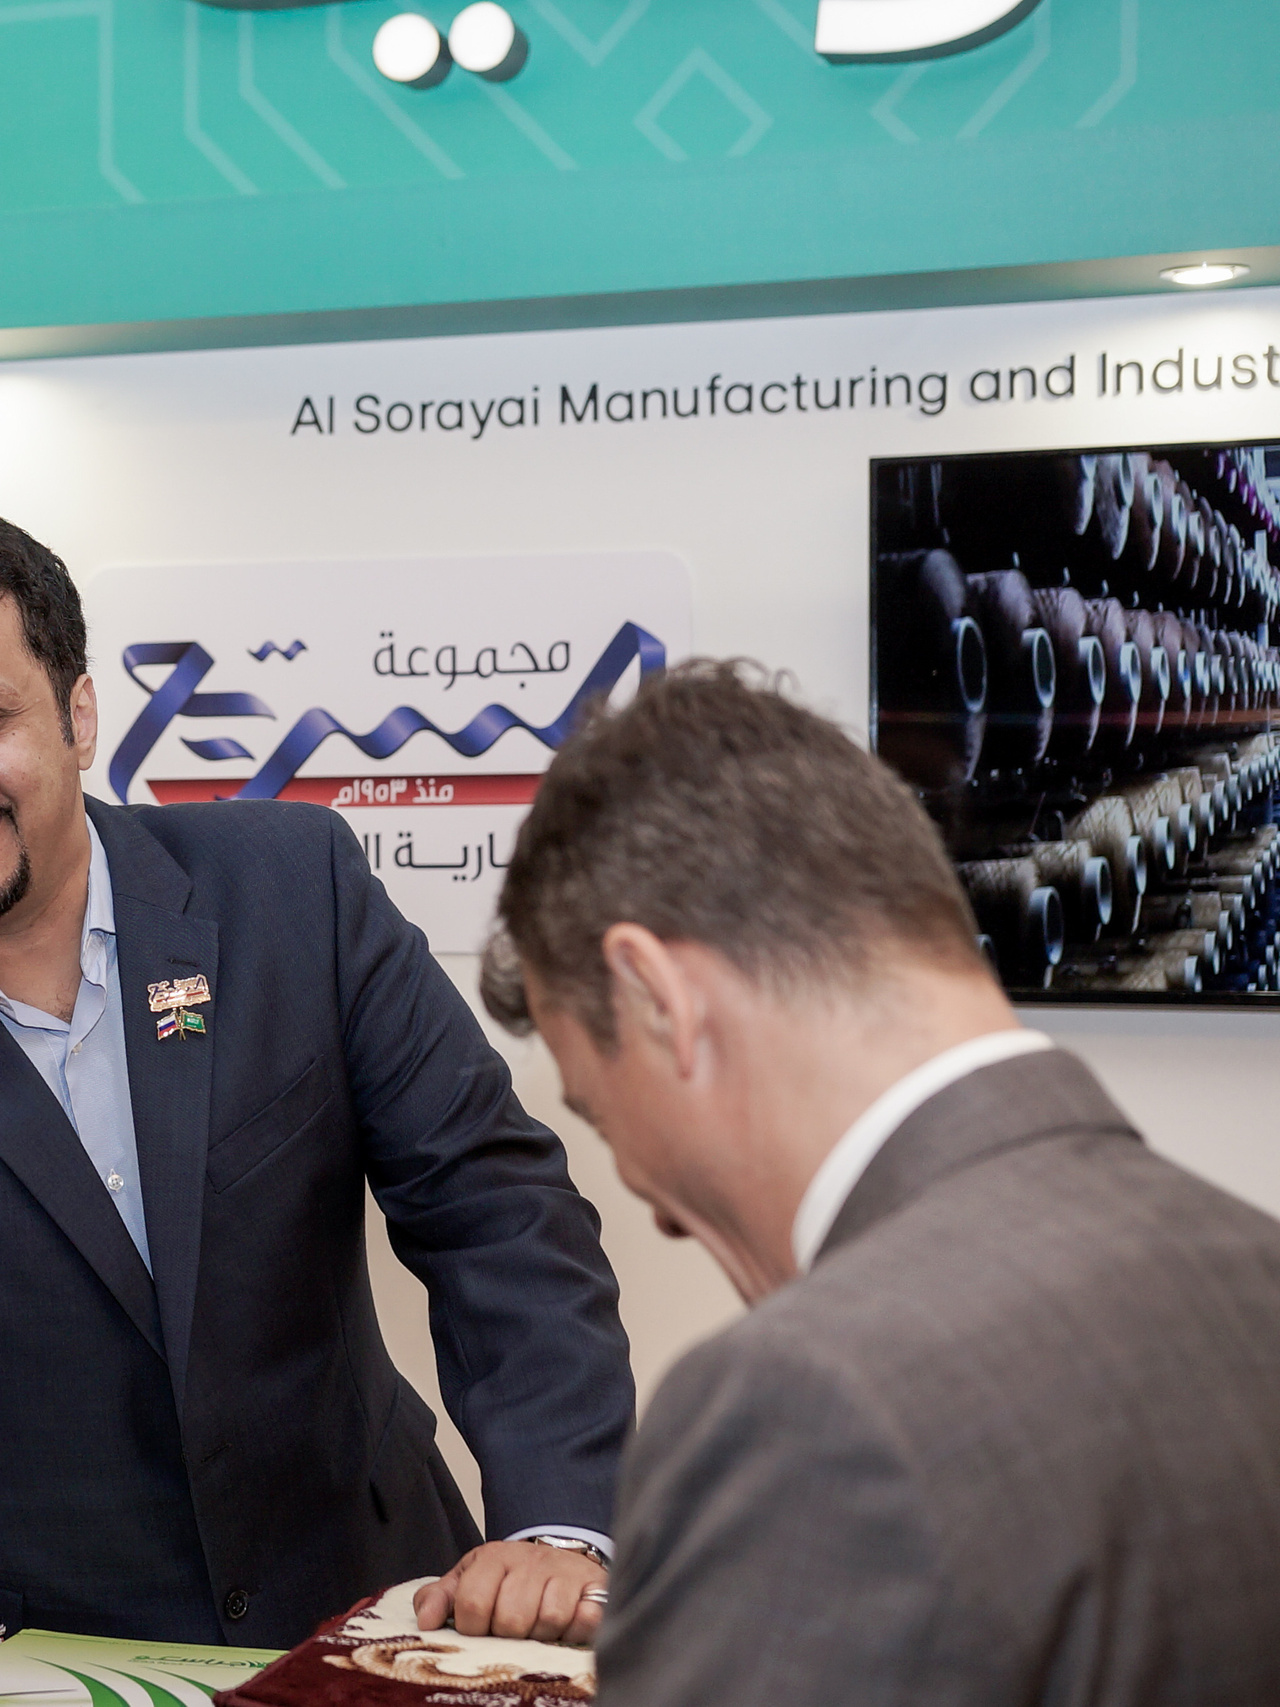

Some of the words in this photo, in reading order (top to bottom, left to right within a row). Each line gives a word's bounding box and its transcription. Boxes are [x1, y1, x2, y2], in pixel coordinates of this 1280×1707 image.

[291, 395, 334, 436] Al
[354, 385, 540, 441] Sorayai
[559, 365, 948, 424] Manufacturing
[969, 354, 1075, 402] and
[1099, 345, 1280, 397] Indust
[372, 631, 571, 690] مجموعة
[412, 777, 455, 804] منذ
